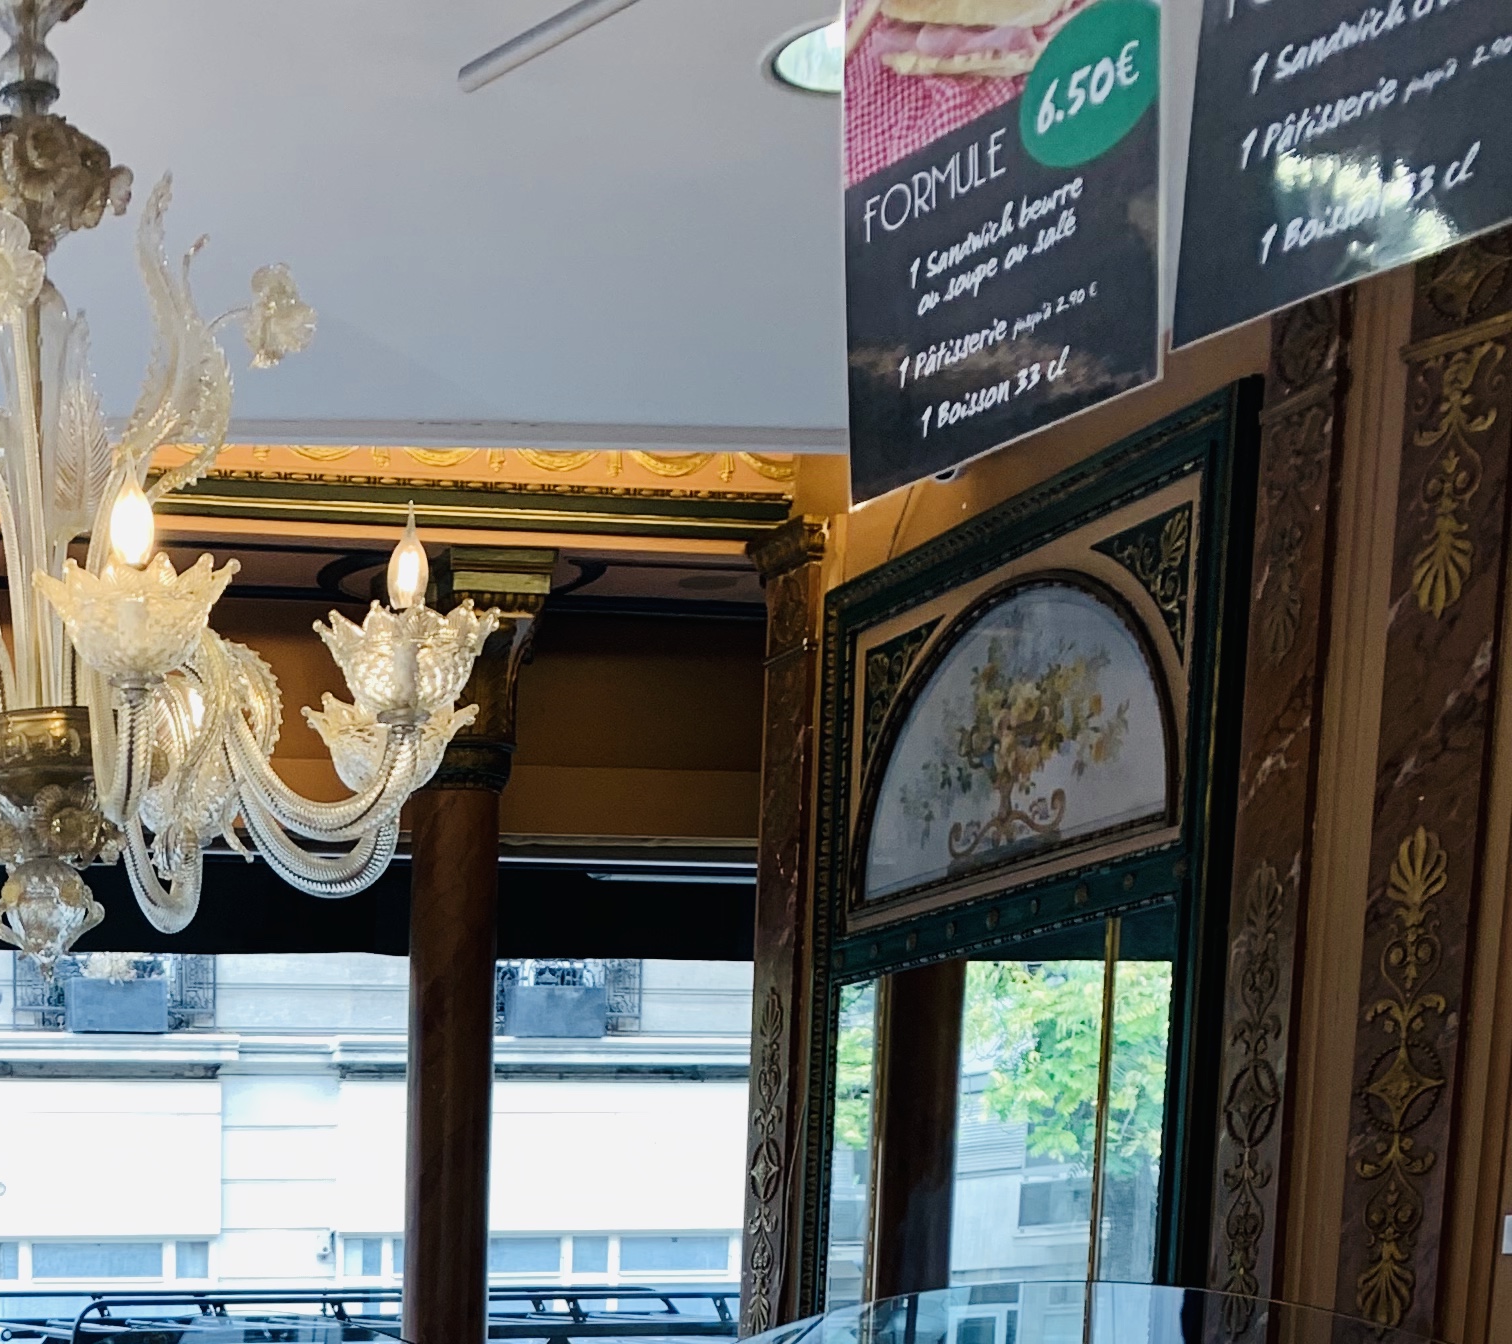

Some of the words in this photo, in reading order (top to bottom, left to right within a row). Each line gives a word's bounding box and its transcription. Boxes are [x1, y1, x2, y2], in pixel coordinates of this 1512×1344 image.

[1036, 40, 1140, 134] 6.50€
[1251, 52, 1269, 95] 1
[1273, 0, 1407, 81] Sandwich
[1241, 128, 1258, 170] 1
[1262, 76, 1399, 157] Pâtisserie
[864, 127, 1006, 243] FORMULE
[1261, 223, 1278, 265] 1
[1443, 140, 1481, 190] cl
[909, 257, 920, 290] 1
[926, 200, 1015, 278] Sandwich
[1018, 176, 1084, 229] beurre
[917, 291, 940, 317] ou
[943, 257, 998, 298] soupe
[1004, 243, 1029, 270] ou
[1032, 206, 1078, 255] salé
[899, 355, 910, 389] 1
[914, 318, 1008, 381] Pâtisserie
[921, 405, 933, 440] 1
[937, 379, 1011, 429] Boisson
[1014, 361, 1041, 396] 33
[1046, 345, 1071, 382] cl
